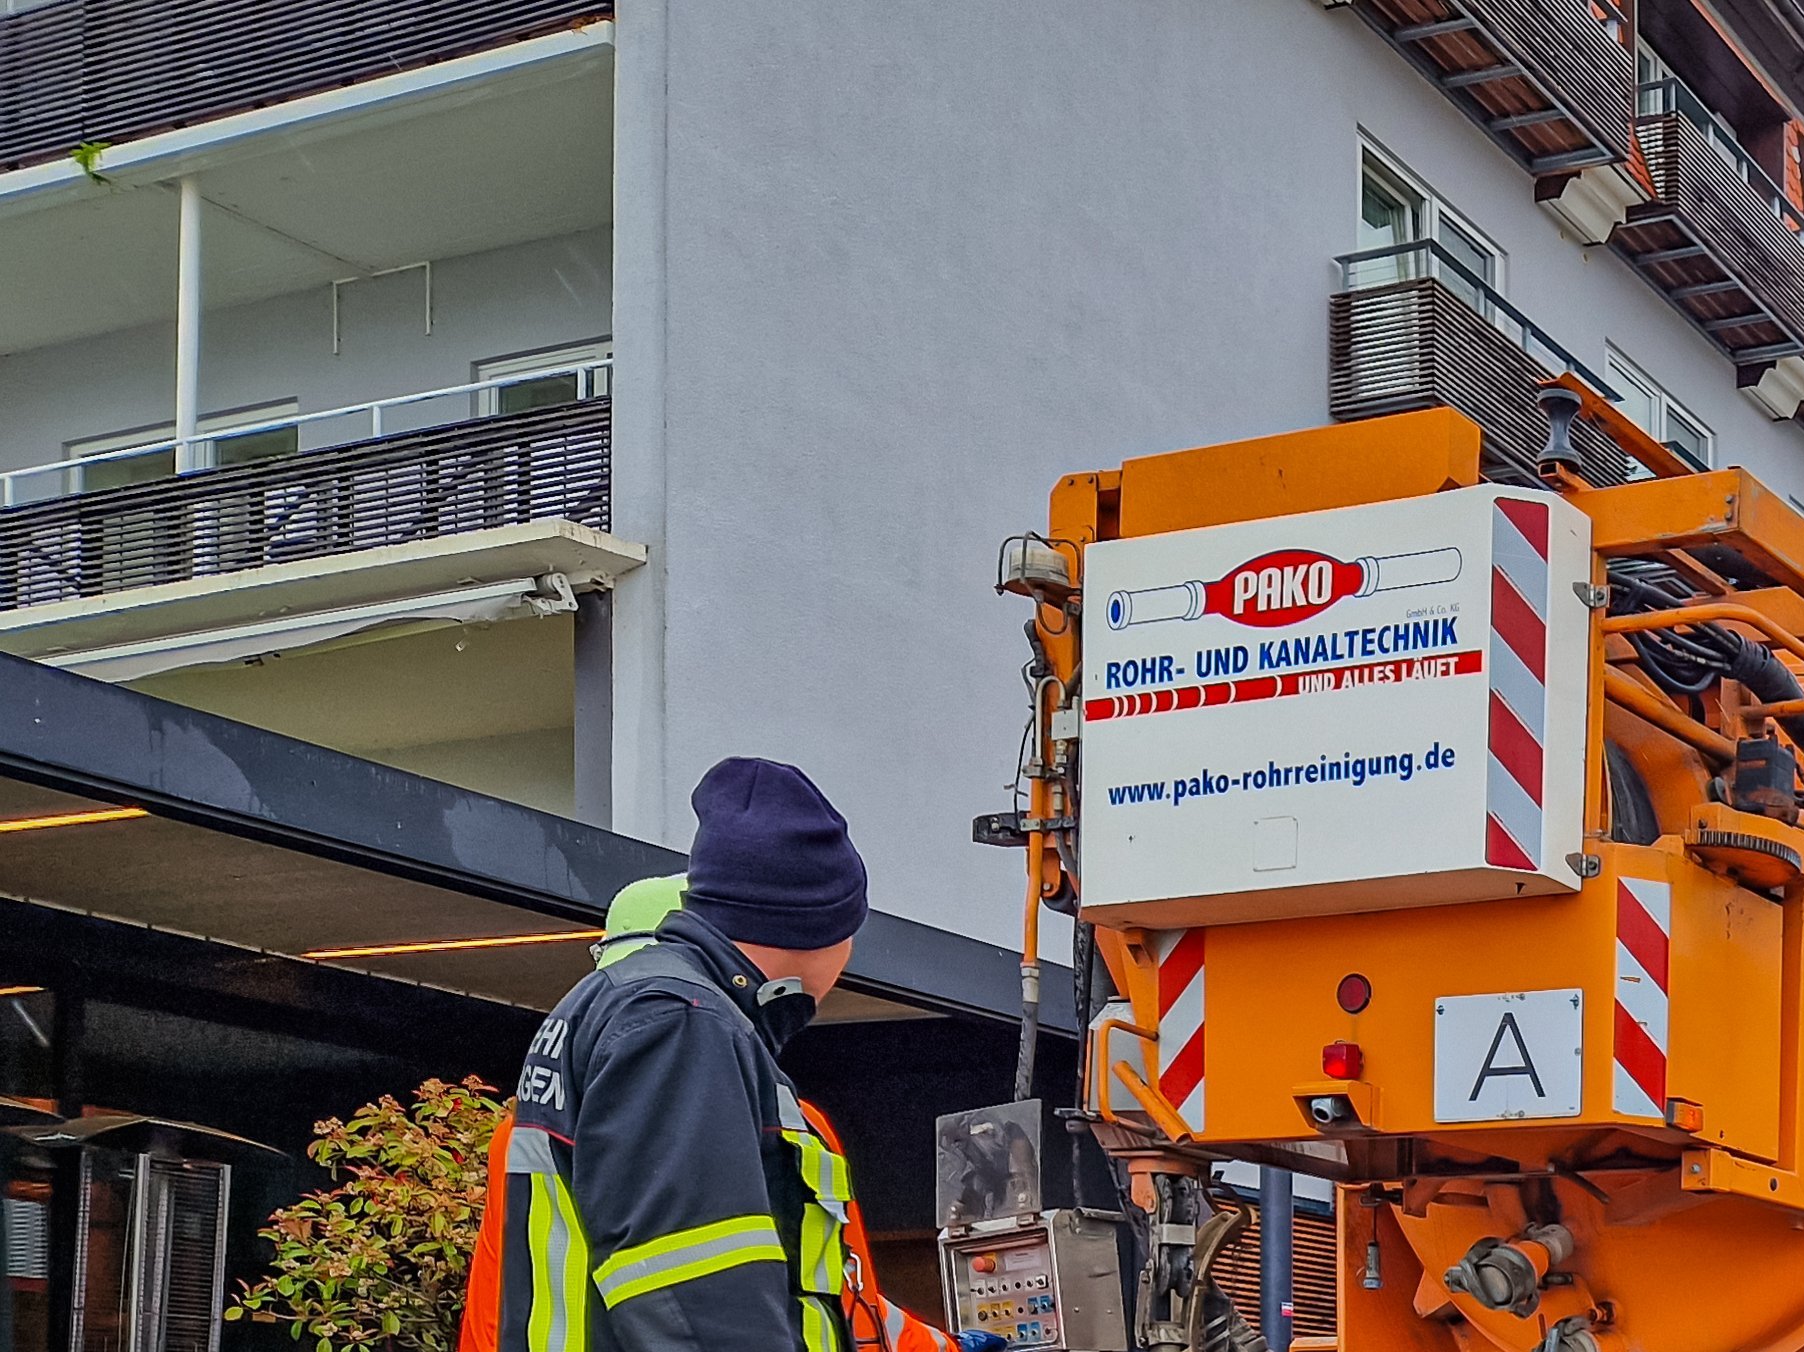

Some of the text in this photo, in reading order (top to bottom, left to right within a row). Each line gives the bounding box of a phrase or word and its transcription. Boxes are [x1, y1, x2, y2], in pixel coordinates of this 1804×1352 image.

[1233, 559, 1333, 615] PAKO
[1106, 616, 1458, 690] ROHR- UND KANALTECHNIK
[1298, 655, 1459, 695] UND ALLES LÄUFT
[1108, 742, 1456, 806] www.pako-rohrreinigung.de
[1468, 1011, 1547, 1103] A
